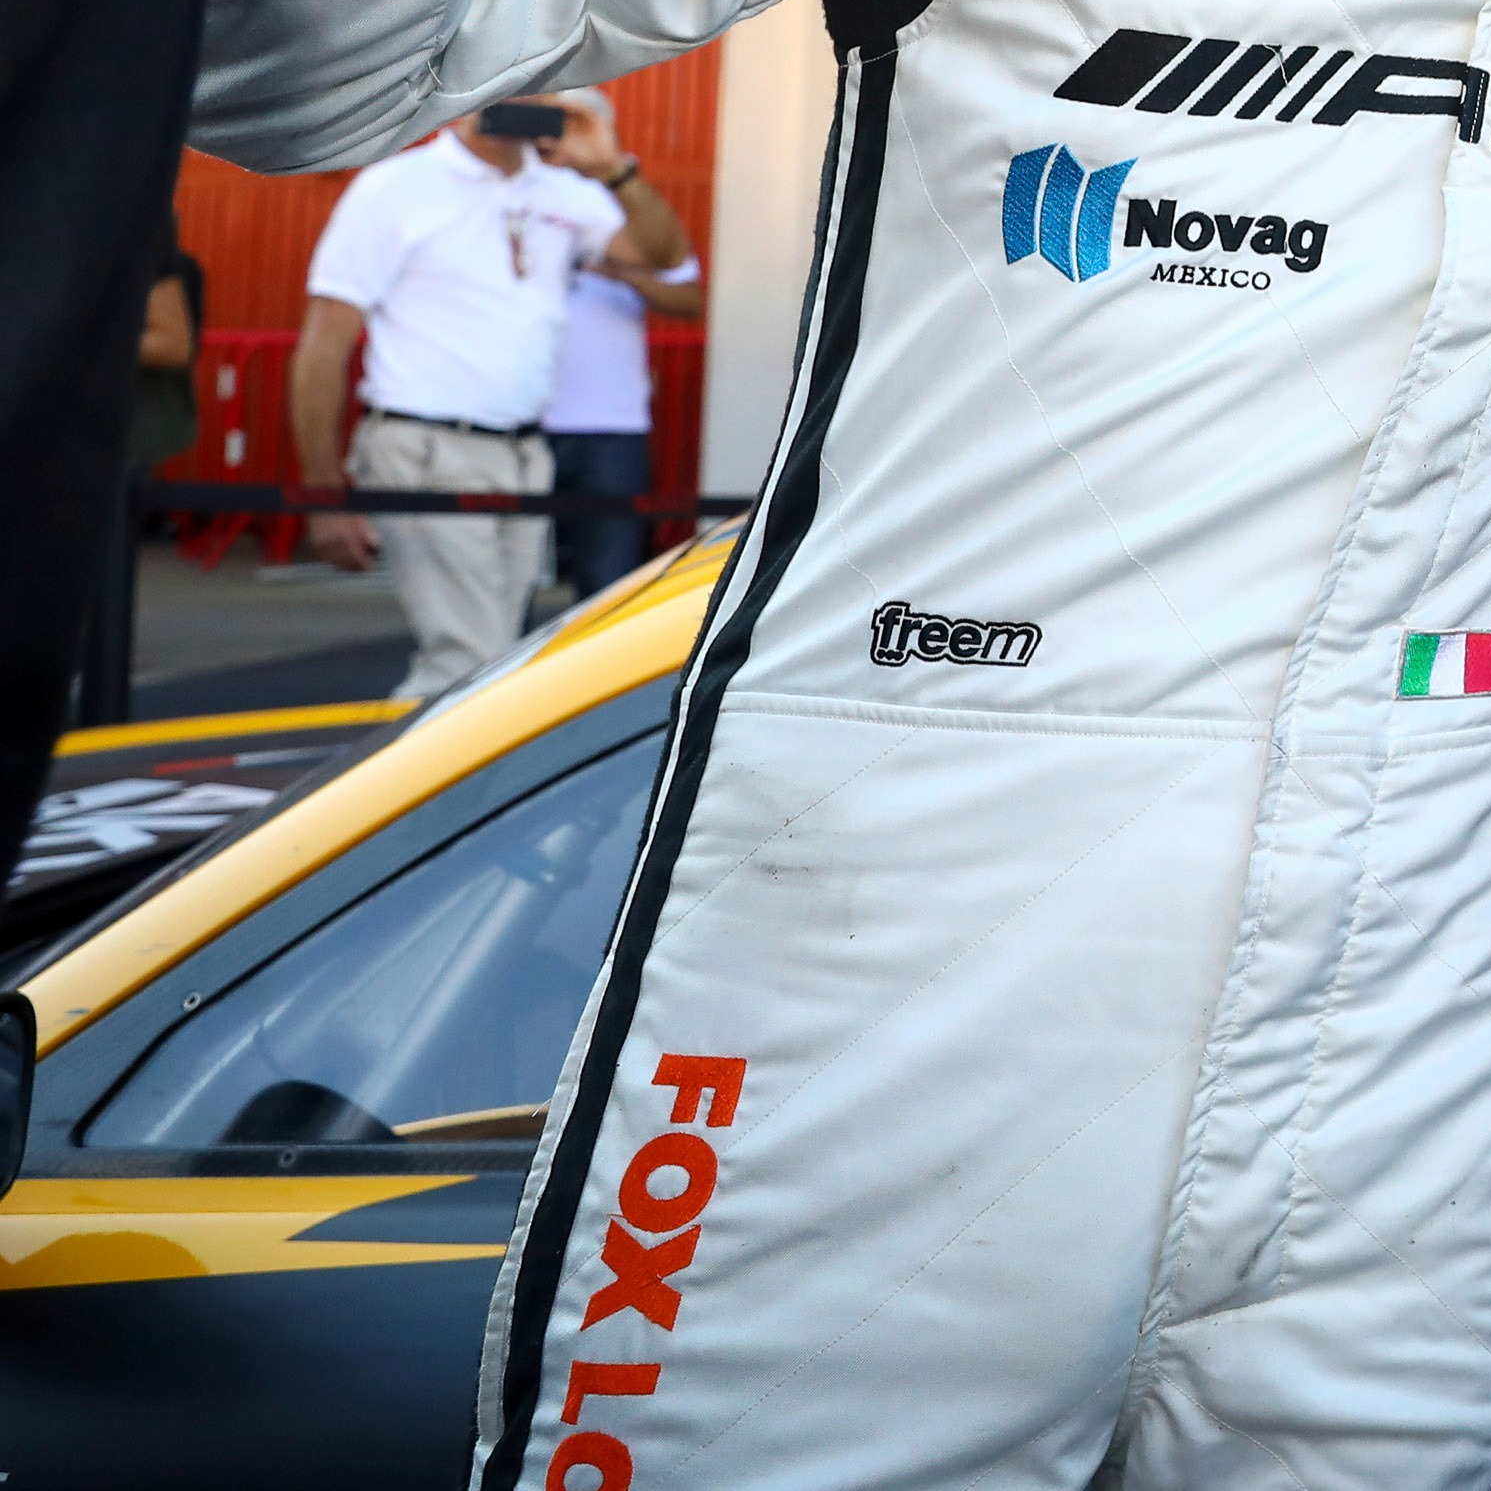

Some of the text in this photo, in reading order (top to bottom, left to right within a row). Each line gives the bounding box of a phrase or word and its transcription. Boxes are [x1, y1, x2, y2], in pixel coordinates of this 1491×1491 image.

[1123, 198, 1330, 274] Novag
[1149, 263, 1272, 292] MEXICO
[876, 606, 1036, 661] freem
[580, 1053, 747, 1333] FOX
